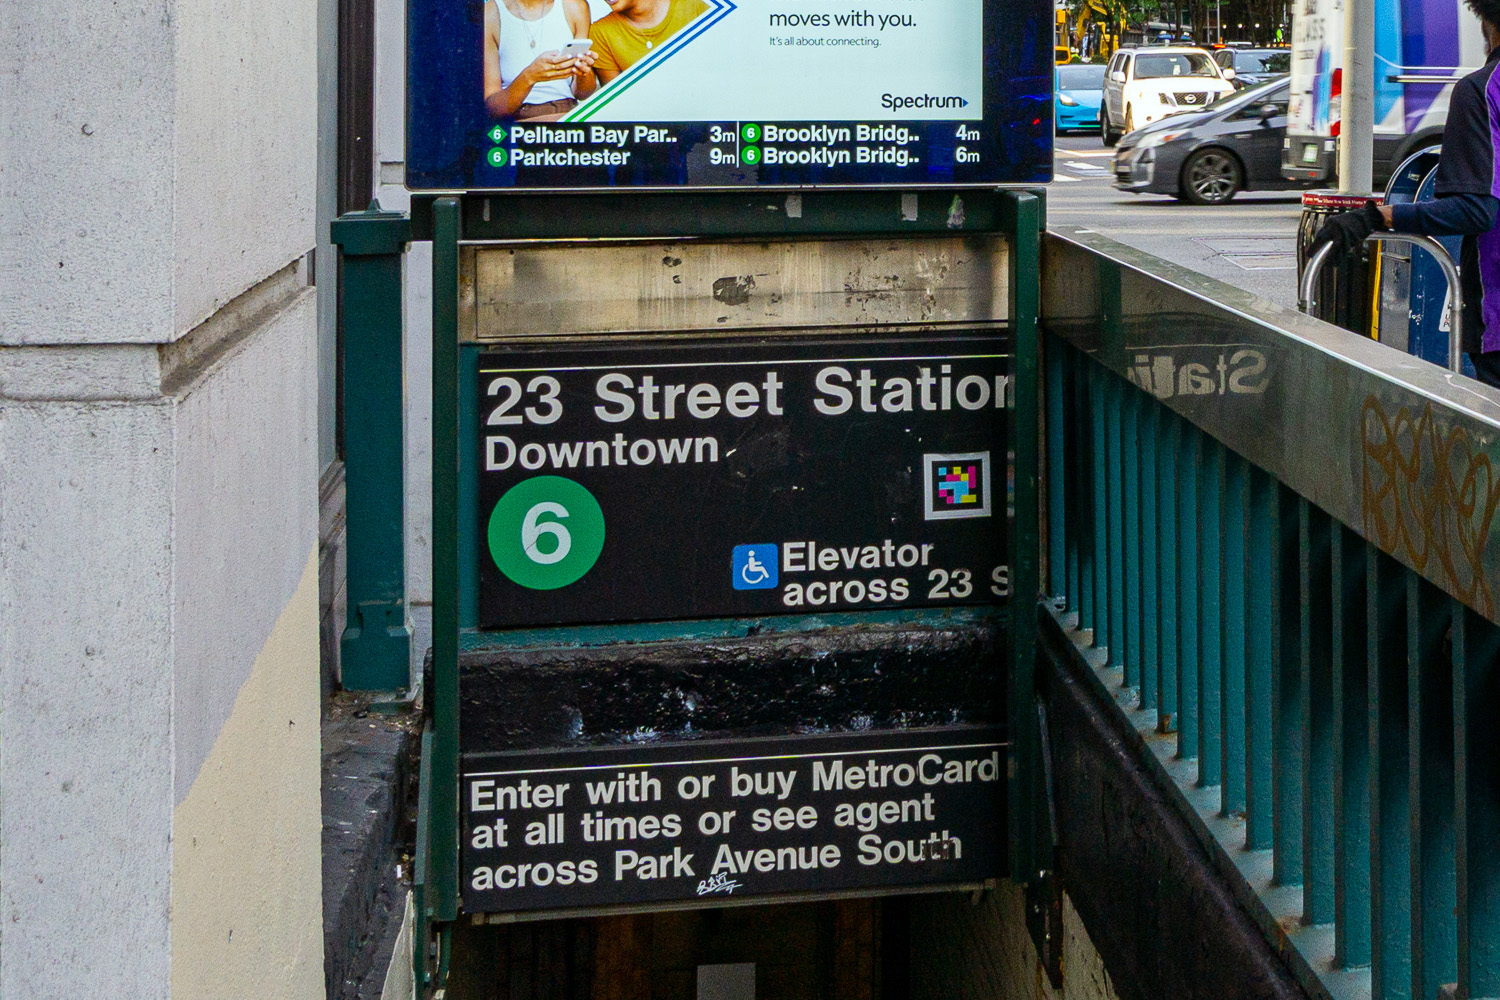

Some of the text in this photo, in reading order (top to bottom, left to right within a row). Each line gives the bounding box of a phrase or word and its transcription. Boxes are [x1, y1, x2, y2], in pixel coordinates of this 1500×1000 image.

[769, 9, 917, 31] moves with you.
[769, 36, 882, 48] It's all about connecting.
[881, 93, 963, 112] Spectrum
[493, 125, 736, 148] 6 Pelham Bay Par.. 3m
[746, 124, 980, 146] 6 Brooklyn Bridg.. 4m
[493, 148, 736, 166] 6 Parkchester 9m
[746, 146, 980, 168] 6 Brooklyn Bridg.. 6m
[486, 374, 563, 426] 23
[594, 370, 784, 423] Street
[484, 432, 719, 471] Downtown
[520, 501, 573, 565] 6
[782, 538, 935, 573] Elevator
[782, 575, 910, 607] across
[927, 567, 974, 599] 23
[471, 751, 999, 812] Enter with or buy MetroCard
[471, 792, 935, 849] at all times or see agent
[471, 830, 962, 891] across Park Avenue South
